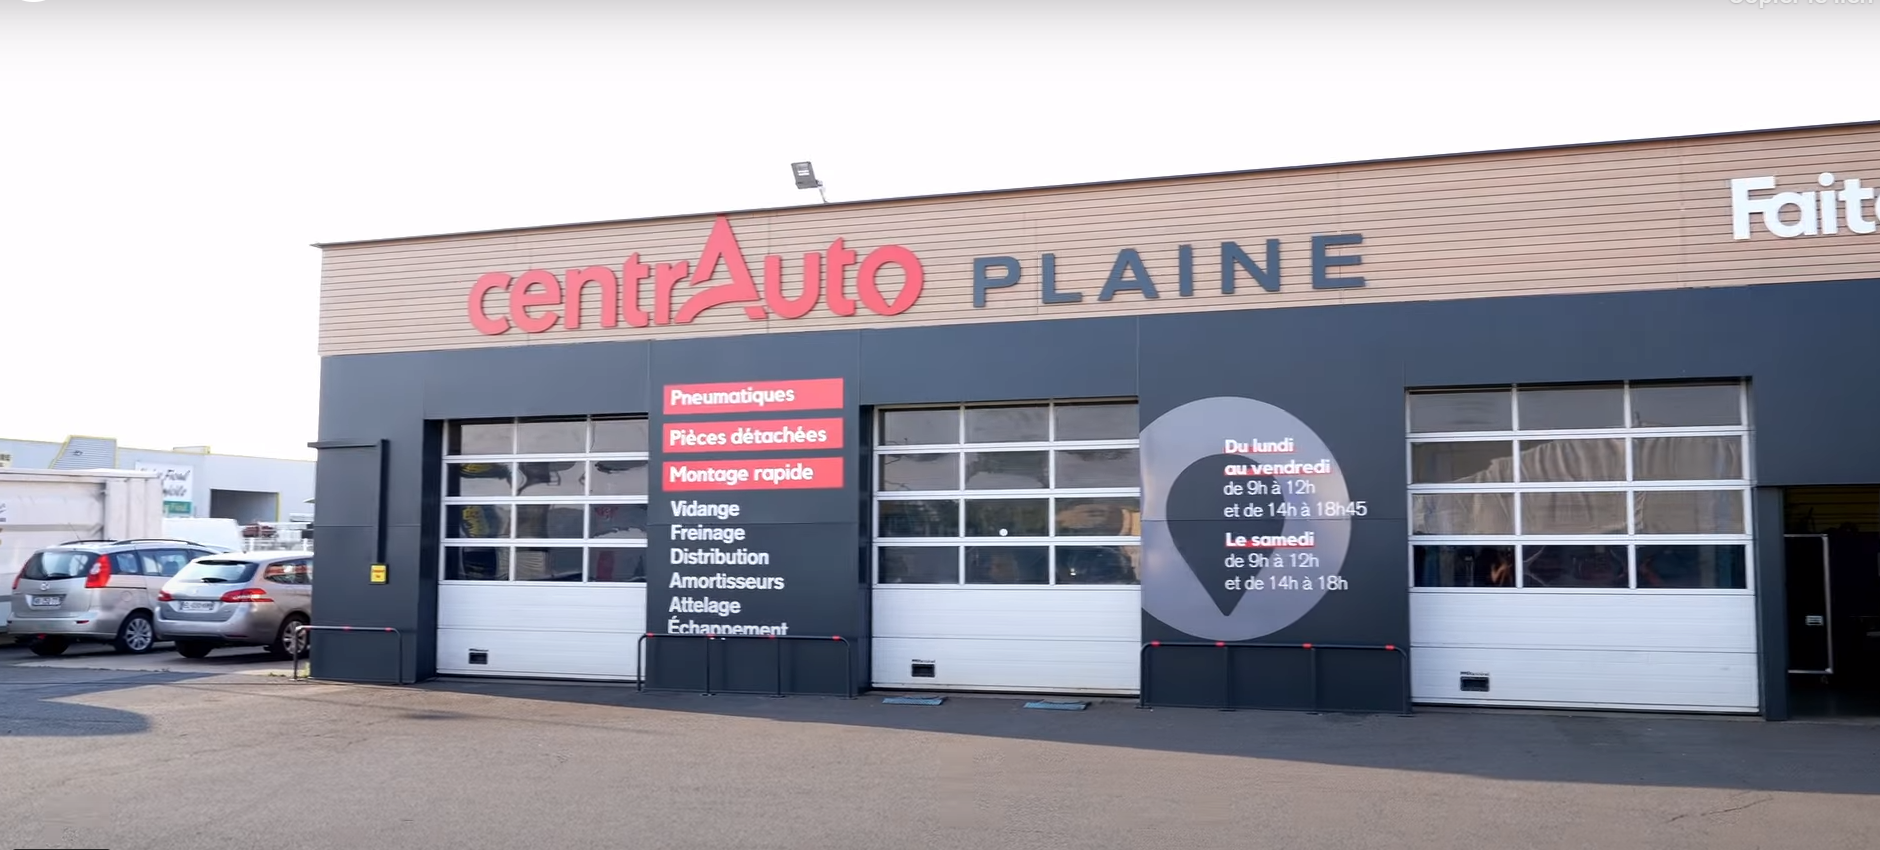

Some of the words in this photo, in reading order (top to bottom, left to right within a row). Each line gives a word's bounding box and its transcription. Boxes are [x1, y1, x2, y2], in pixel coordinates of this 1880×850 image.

[1730, 172, 1880, 240] Fait
[468, 213, 925, 336] centrAuto
[972, 233, 1367, 308] PLAINE
[670, 387, 795, 407] Pneumatiques
[669, 429, 727, 446] Pièces
[730, 426, 827, 445] détachées
[1224, 439, 1249, 454] Du
[1252, 438, 1294, 453] lundi
[669, 466, 749, 486] Montage
[753, 463, 814, 484] rapide
[1224, 463, 1247, 475] au
[1251, 459, 1331, 475] vendredi
[1223, 481, 1244, 495] de
[1247, 480, 1268, 495] 9h
[1270, 480, 1281, 495] à
[1286, 480, 1316, 494] 12h
[670, 500, 740, 520] Vidange
[1223, 504, 1241, 517] et
[1243, 503, 1264, 517] de
[1268, 502, 1298, 517] 14h
[1300, 502, 1311, 517] à
[1316, 501, 1368, 516] 18h45
[670, 524, 746, 544] Freinage
[1225, 532, 1247, 547] Le
[1251, 532, 1315, 547] samedi
[669, 548, 770, 565] Distribution
[1224, 553, 1245, 568] de
[1248, 553, 1269, 568] 9h
[1273, 553, 1284, 568] à
[1289, 553, 1319, 568] 12h
[668, 572, 785, 590] Amortisseurs
[1224, 577, 1241, 590] et
[1244, 576, 1265, 590] de
[1269, 576, 1299, 590] 14h
[1302, 576, 1313, 590] à
[1318, 575, 1348, 590] 18h
[668, 596, 742, 617] Attelage
[667, 615, 790, 639] Échappement
